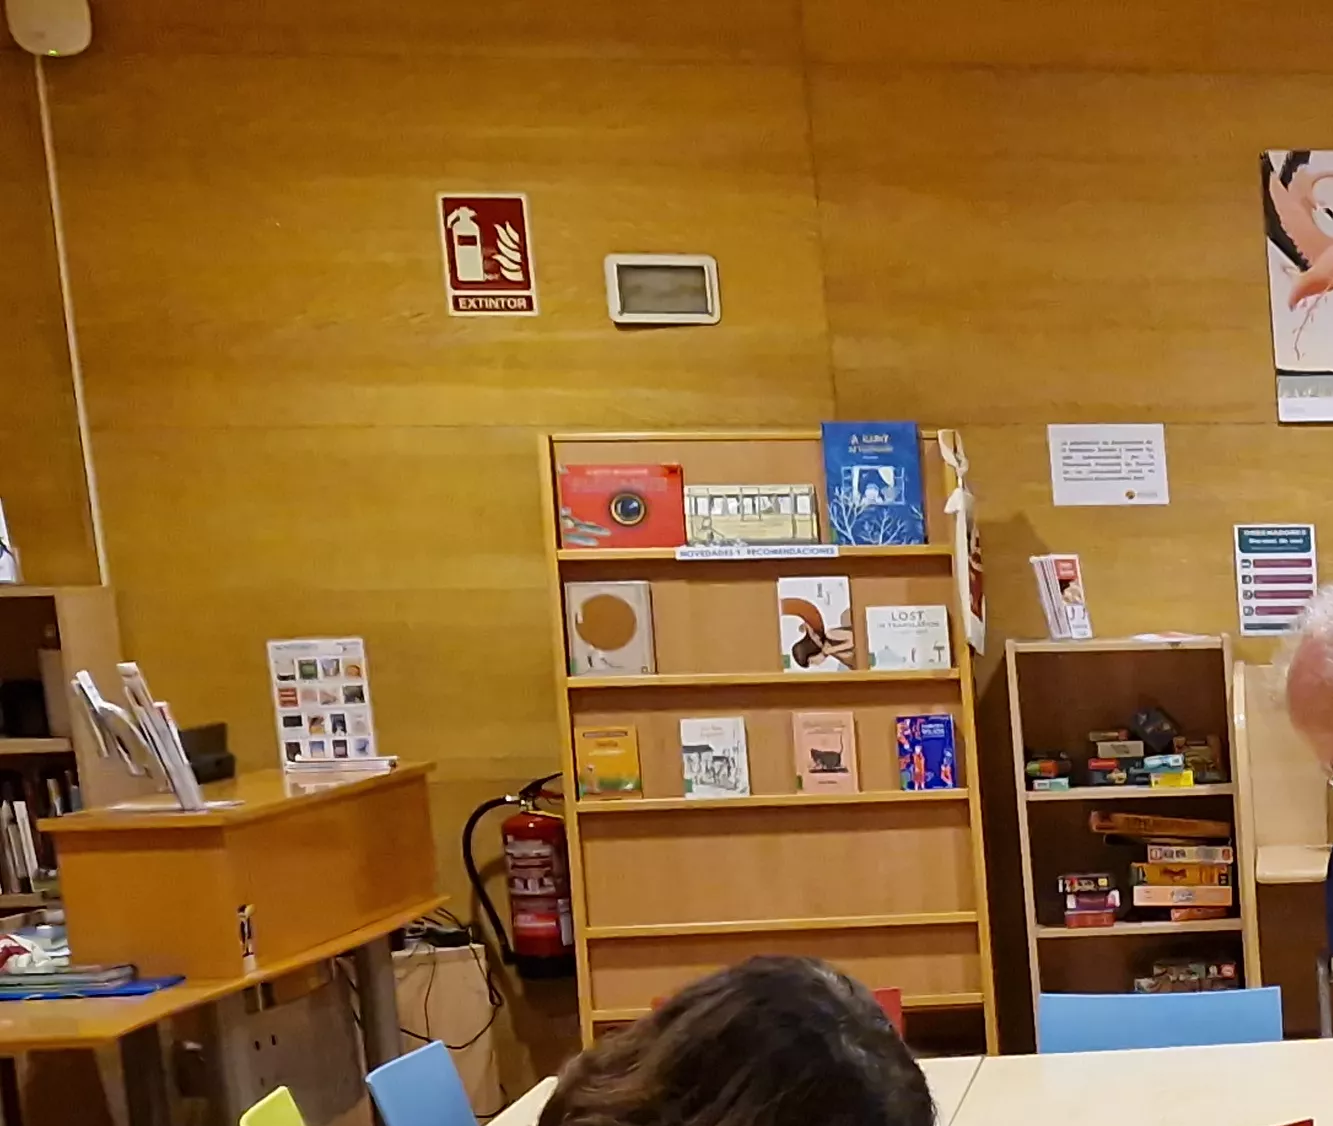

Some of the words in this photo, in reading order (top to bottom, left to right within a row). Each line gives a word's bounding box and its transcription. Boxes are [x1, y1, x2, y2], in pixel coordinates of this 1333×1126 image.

[458, 297, 527, 310] EXTINTOR
[680, 549, 733, 558] NOVEDADES
[891, 611, 926, 622] LOST
